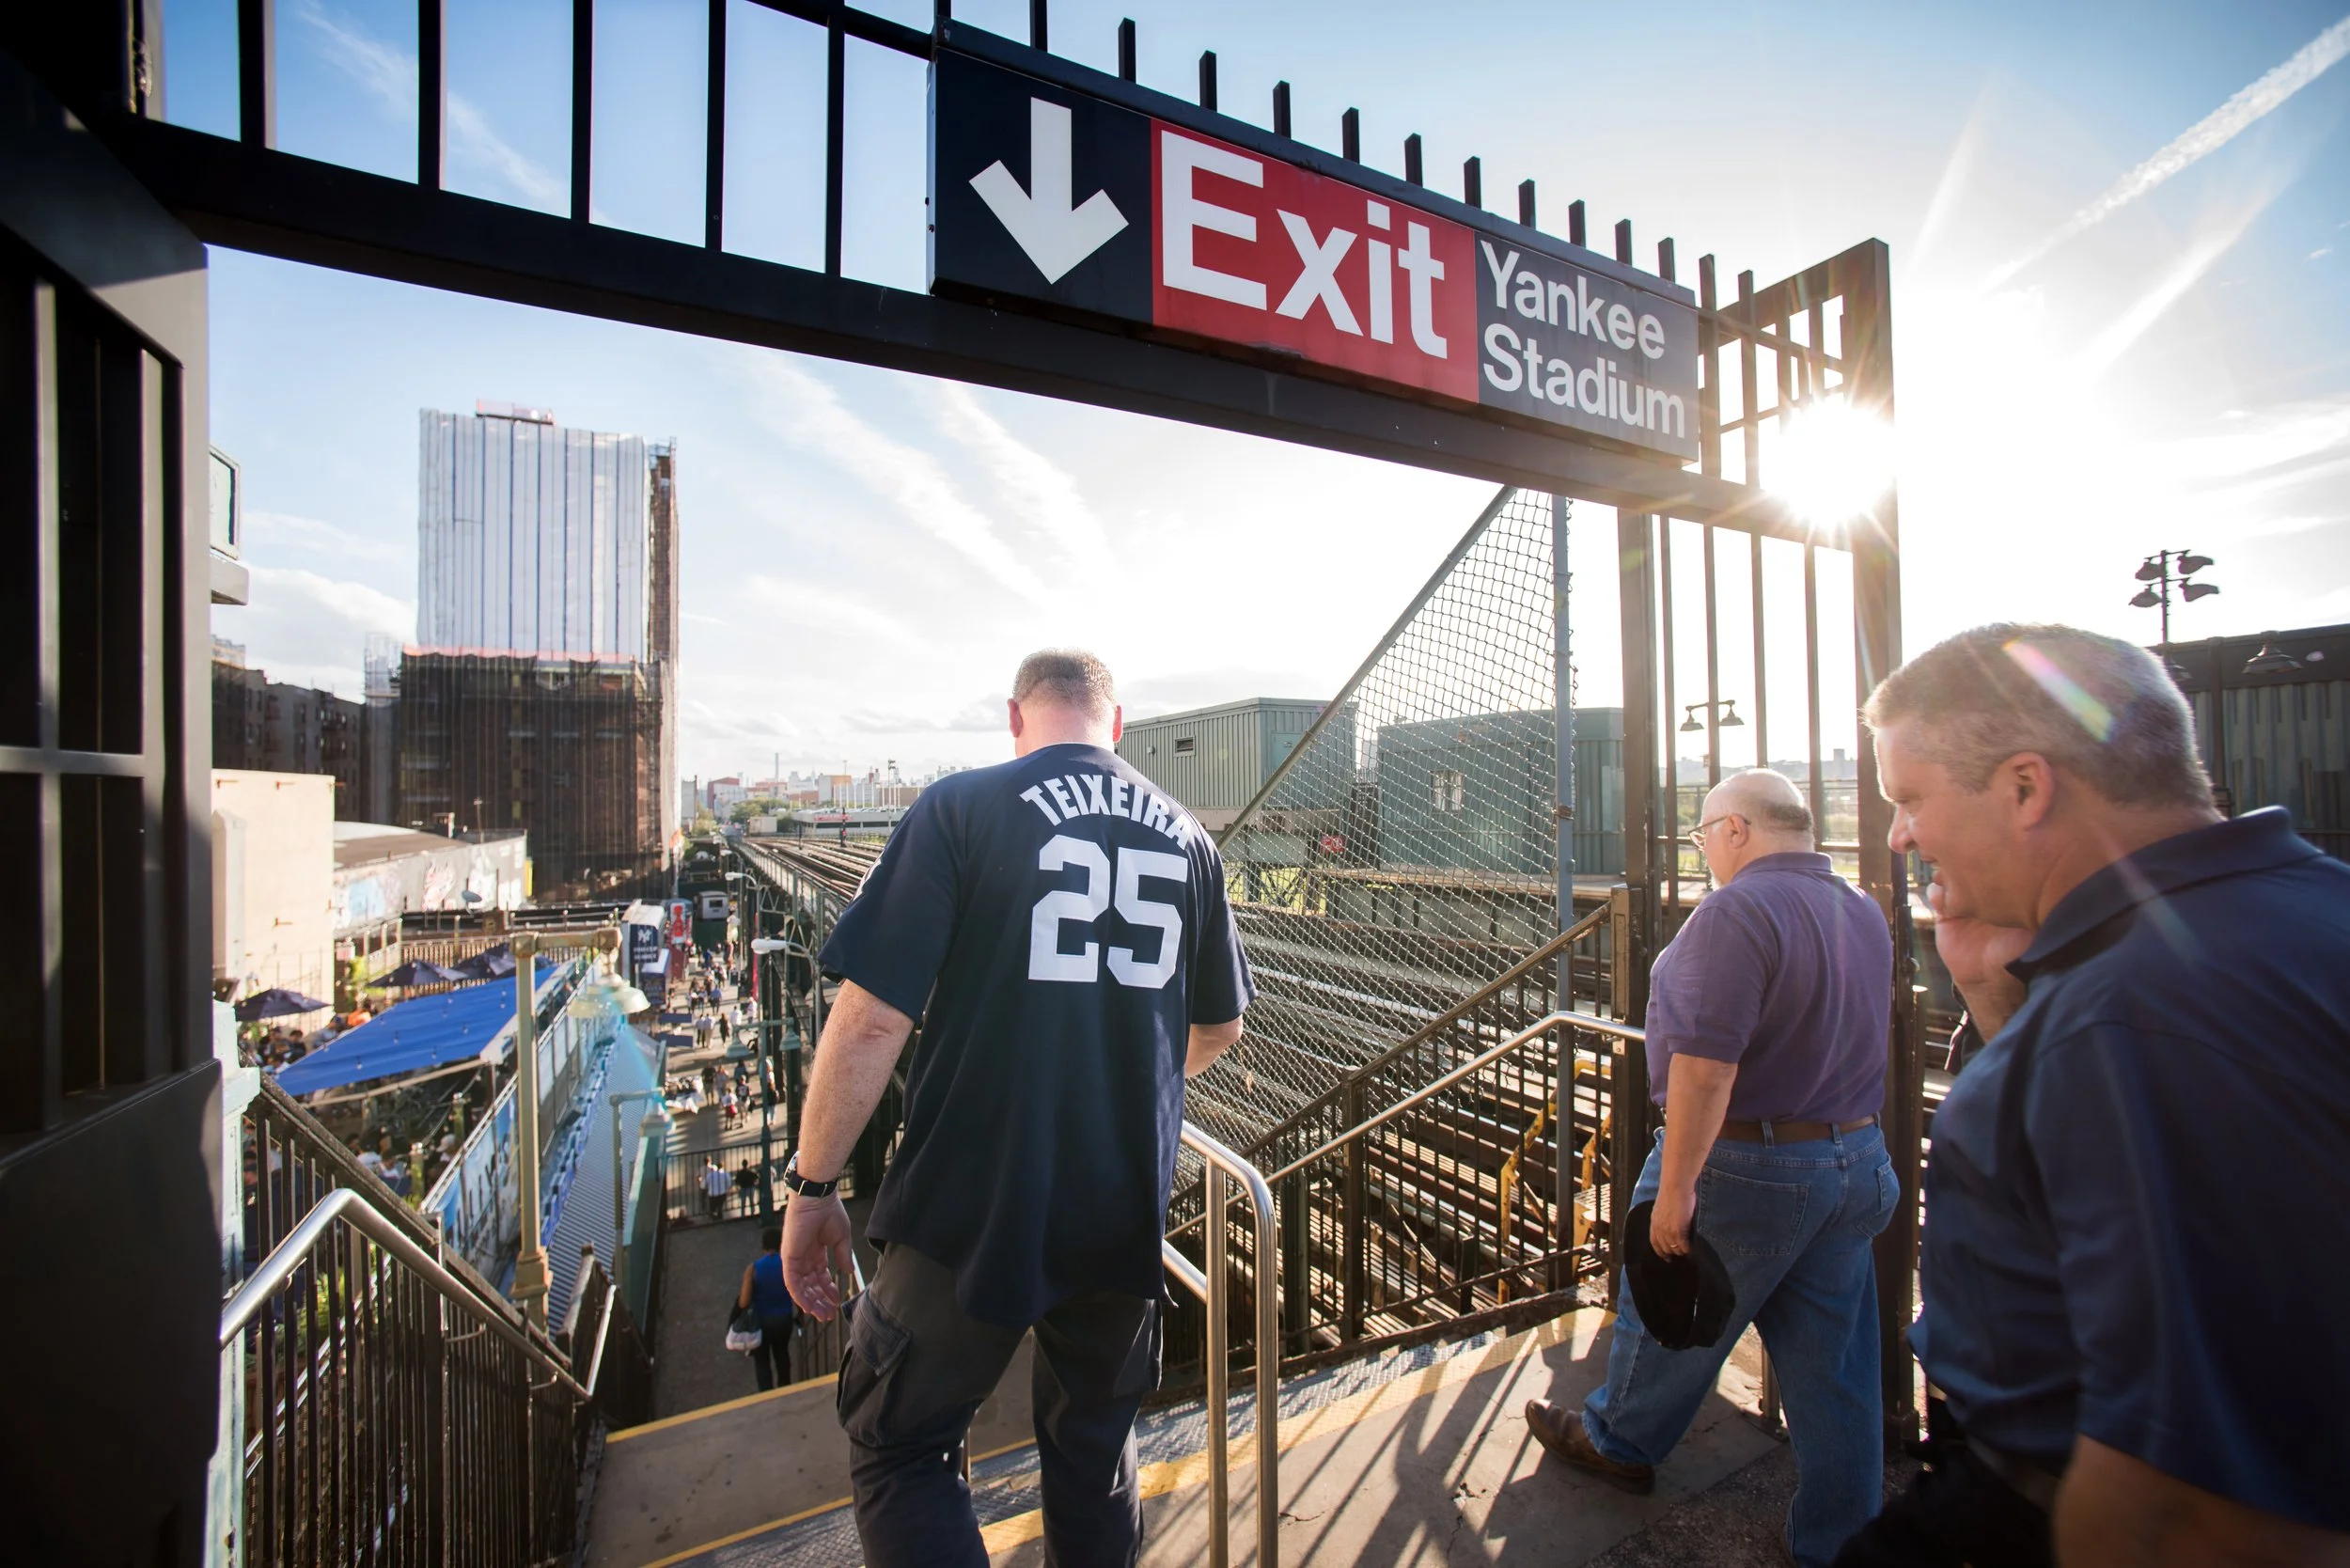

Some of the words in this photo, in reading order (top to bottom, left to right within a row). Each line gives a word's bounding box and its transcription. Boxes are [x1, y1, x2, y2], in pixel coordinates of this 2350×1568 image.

[1161, 129, 1448, 360] Exit
[1480, 240, 1666, 360] Yankee
[1482, 322, 1685, 439] Stadium
[1019, 774, 1194, 851] TEIXEIRA
[1028, 834, 1188, 990] 25
